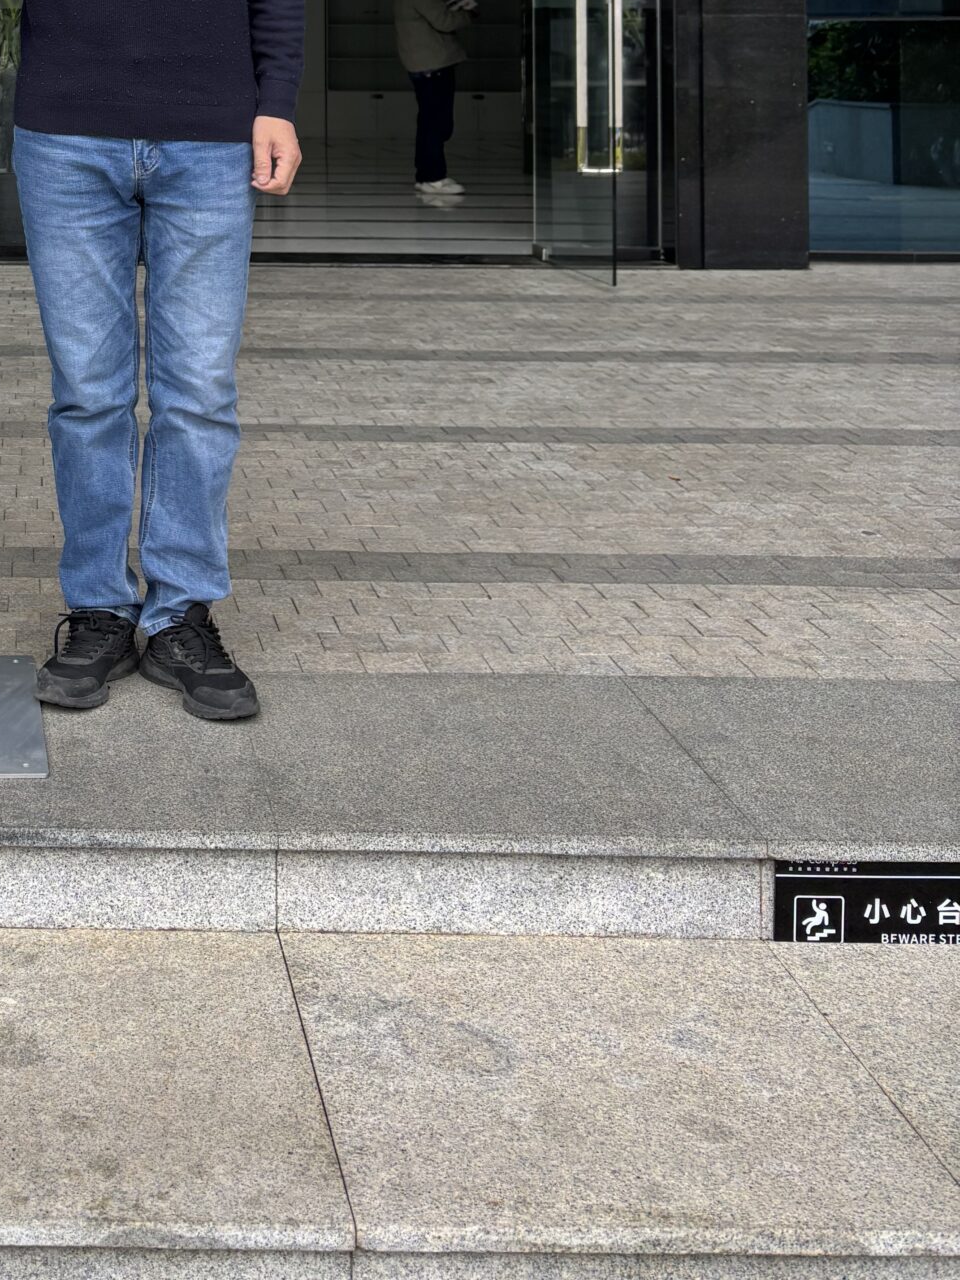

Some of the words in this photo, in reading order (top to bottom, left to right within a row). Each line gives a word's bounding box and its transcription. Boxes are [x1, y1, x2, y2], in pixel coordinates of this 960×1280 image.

[863, 897, 960, 926] 小心台
[881, 933, 936, 945] BEWARE
